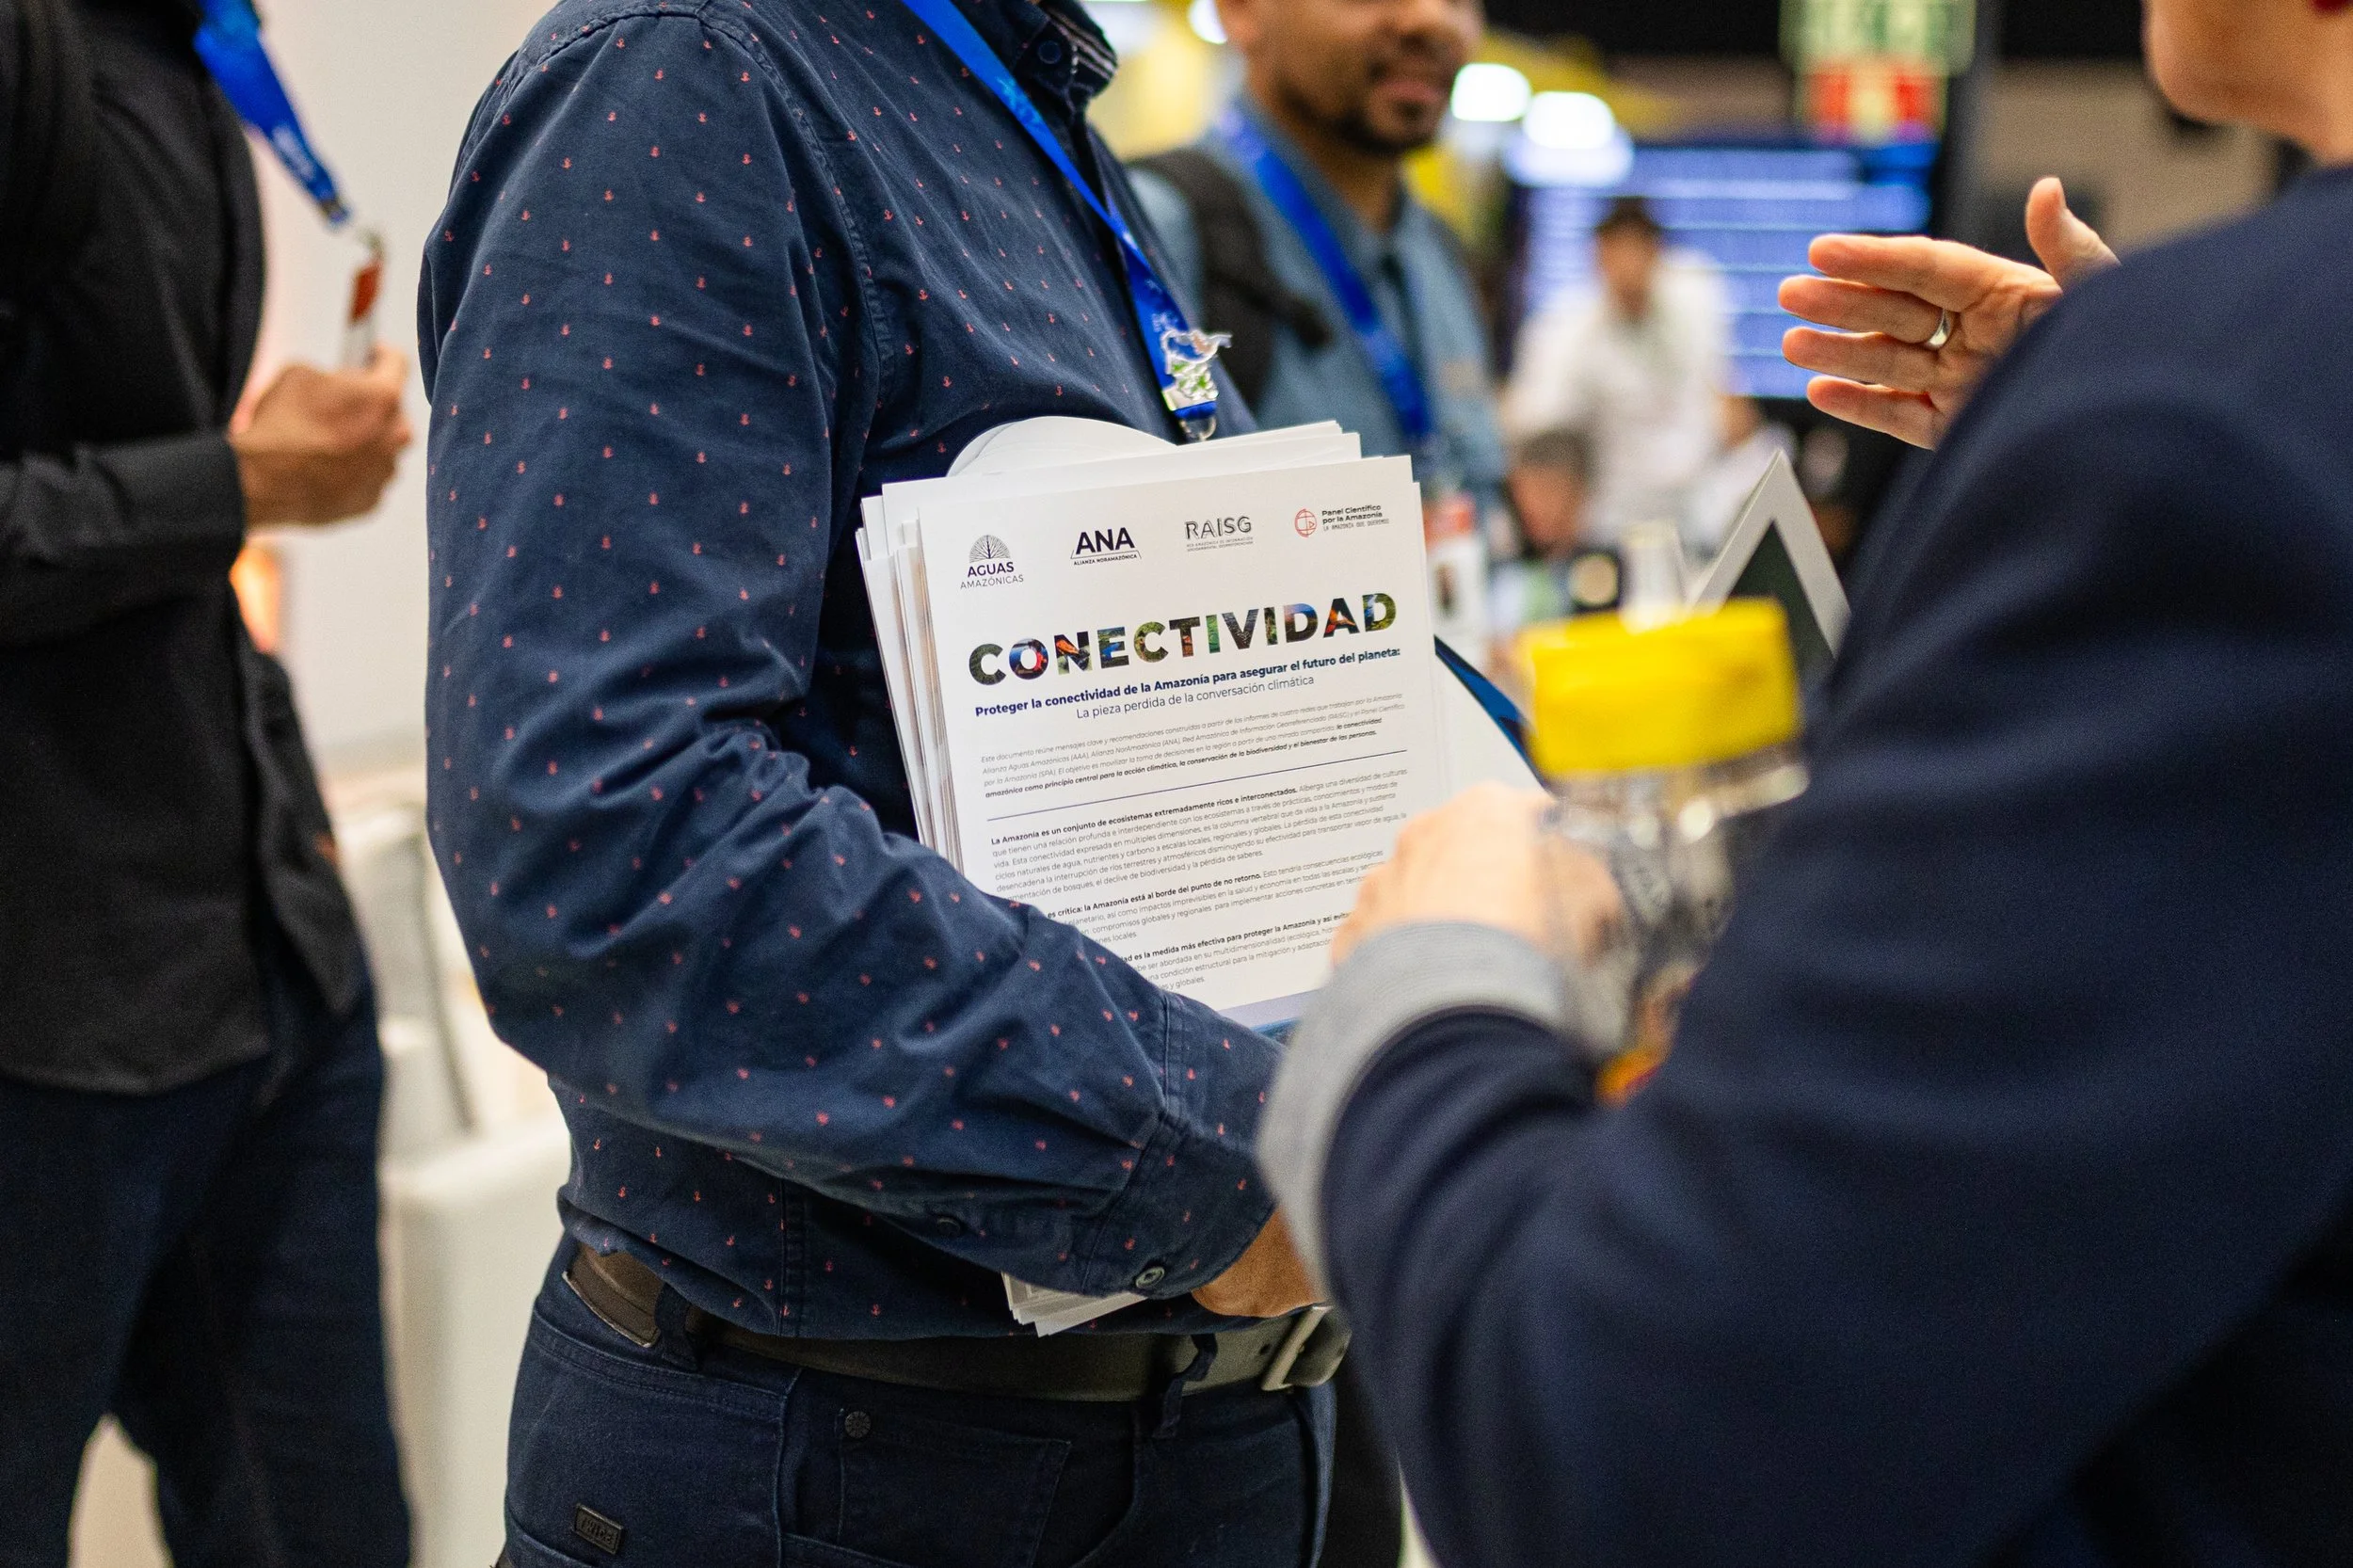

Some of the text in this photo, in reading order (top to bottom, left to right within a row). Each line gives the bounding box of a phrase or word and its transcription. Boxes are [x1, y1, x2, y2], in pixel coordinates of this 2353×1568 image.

[1185, 515, 1251, 539] RAISG
[1345, 512, 1382, 520] Amazonía
[1075, 526, 1135, 554] ANA
[960, 573, 1024, 589] AMAZÓNICAS
[967, 561, 1014, 577] AGUAS
[968, 592, 1396, 685] CONECTIVIDAD
[974, 648, 1401, 717] Proteger la conectividad de la Amazonía para asegurar el futuro del planeta:
[1076, 676, 1314, 718] La pieza perdida de la conversación climática
[984, 786, 1023, 798] amazónica
[1024, 783, 1043, 792] como
[1044, 777, 1074, 790] principio
[1074, 773, 1098, 783] central
[1098, 772, 1115, 781] para
[1123, 766, 1145, 776] acción
[1146, 761, 1178, 772] climática,
[1186, 752, 1228, 765] conservación
[1245, 742, 1288, 755] biodiversidad
[1300, 737, 1328, 746] bienestar
[1001, 831, 1039, 843] Amazonía
[1063, 822, 1096, 833] conjunto
[1108, 812, 1153, 824] ecosistemas
[1154, 801, 1215, 817] extremadamente
[1240, 787, 1298, 802] interconectados.
[992, 849, 1007, 858] que
[1008, 845, 1032, 854] tienen
[1078, 830, 1111, 843] profunda
[1028, 847, 1075, 862] conectividad
[1076, 841, 1112, 854] expresada
[995, 872, 1016, 880] ciclos
[1016, 865, 1050, 876] naturales
[996, 878, 1045, 892] desencadena
[1057, 906, 1082, 917] crítica:
[1092, 897, 1128, 909] Amazonía
[1129, 893, 1145, 903] está
[1154, 888, 1176, 898] borde
[1177, 885, 1190, 893] del
[1190, 882, 1212, 892] punto
[1234, 872, 1261, 883] retorno.
[1151, 946, 1179, 956] medida
[1180, 942, 1196, 951] más
[1196, 937, 1225, 948] efectiva
[1225, 934, 1241, 943] para
[1242, 927, 1273, 939] proteger
[1282, 918, 1316, 930] Amazonía
